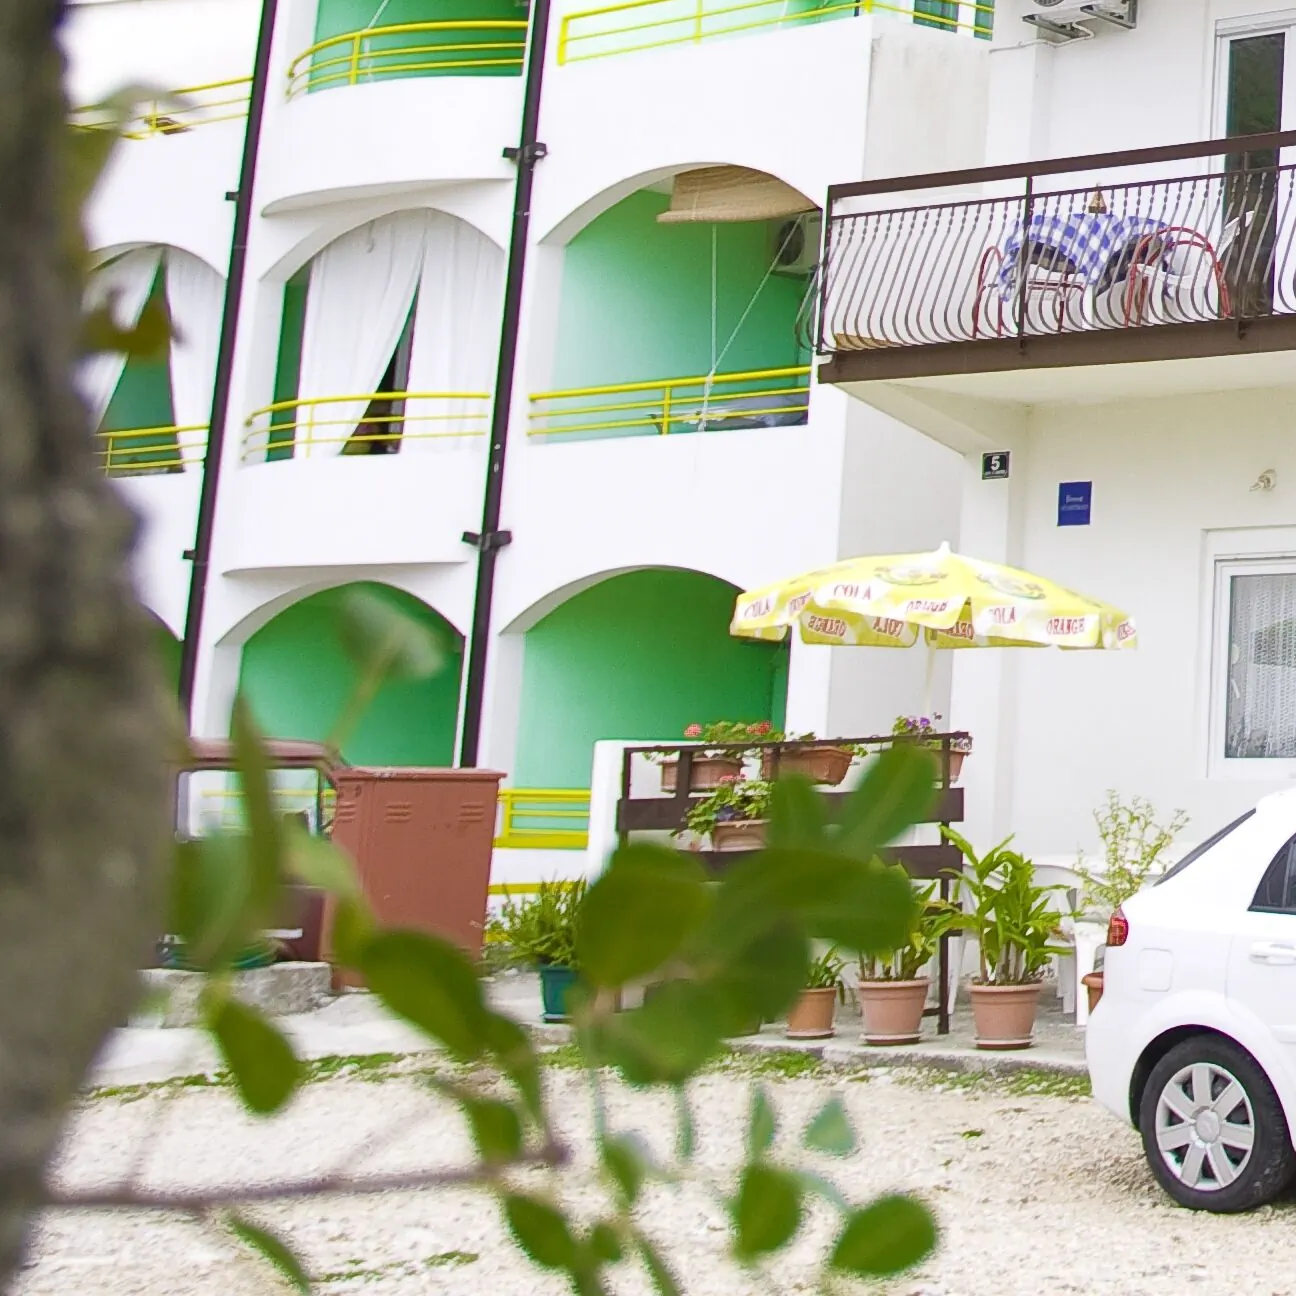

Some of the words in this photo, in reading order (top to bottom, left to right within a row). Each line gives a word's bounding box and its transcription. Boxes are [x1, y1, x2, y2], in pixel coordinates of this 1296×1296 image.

[991, 455, 1001, 471] 5
[834, 584, 871, 601] COLA
[1046, 618, 1085, 635] ORANGE
